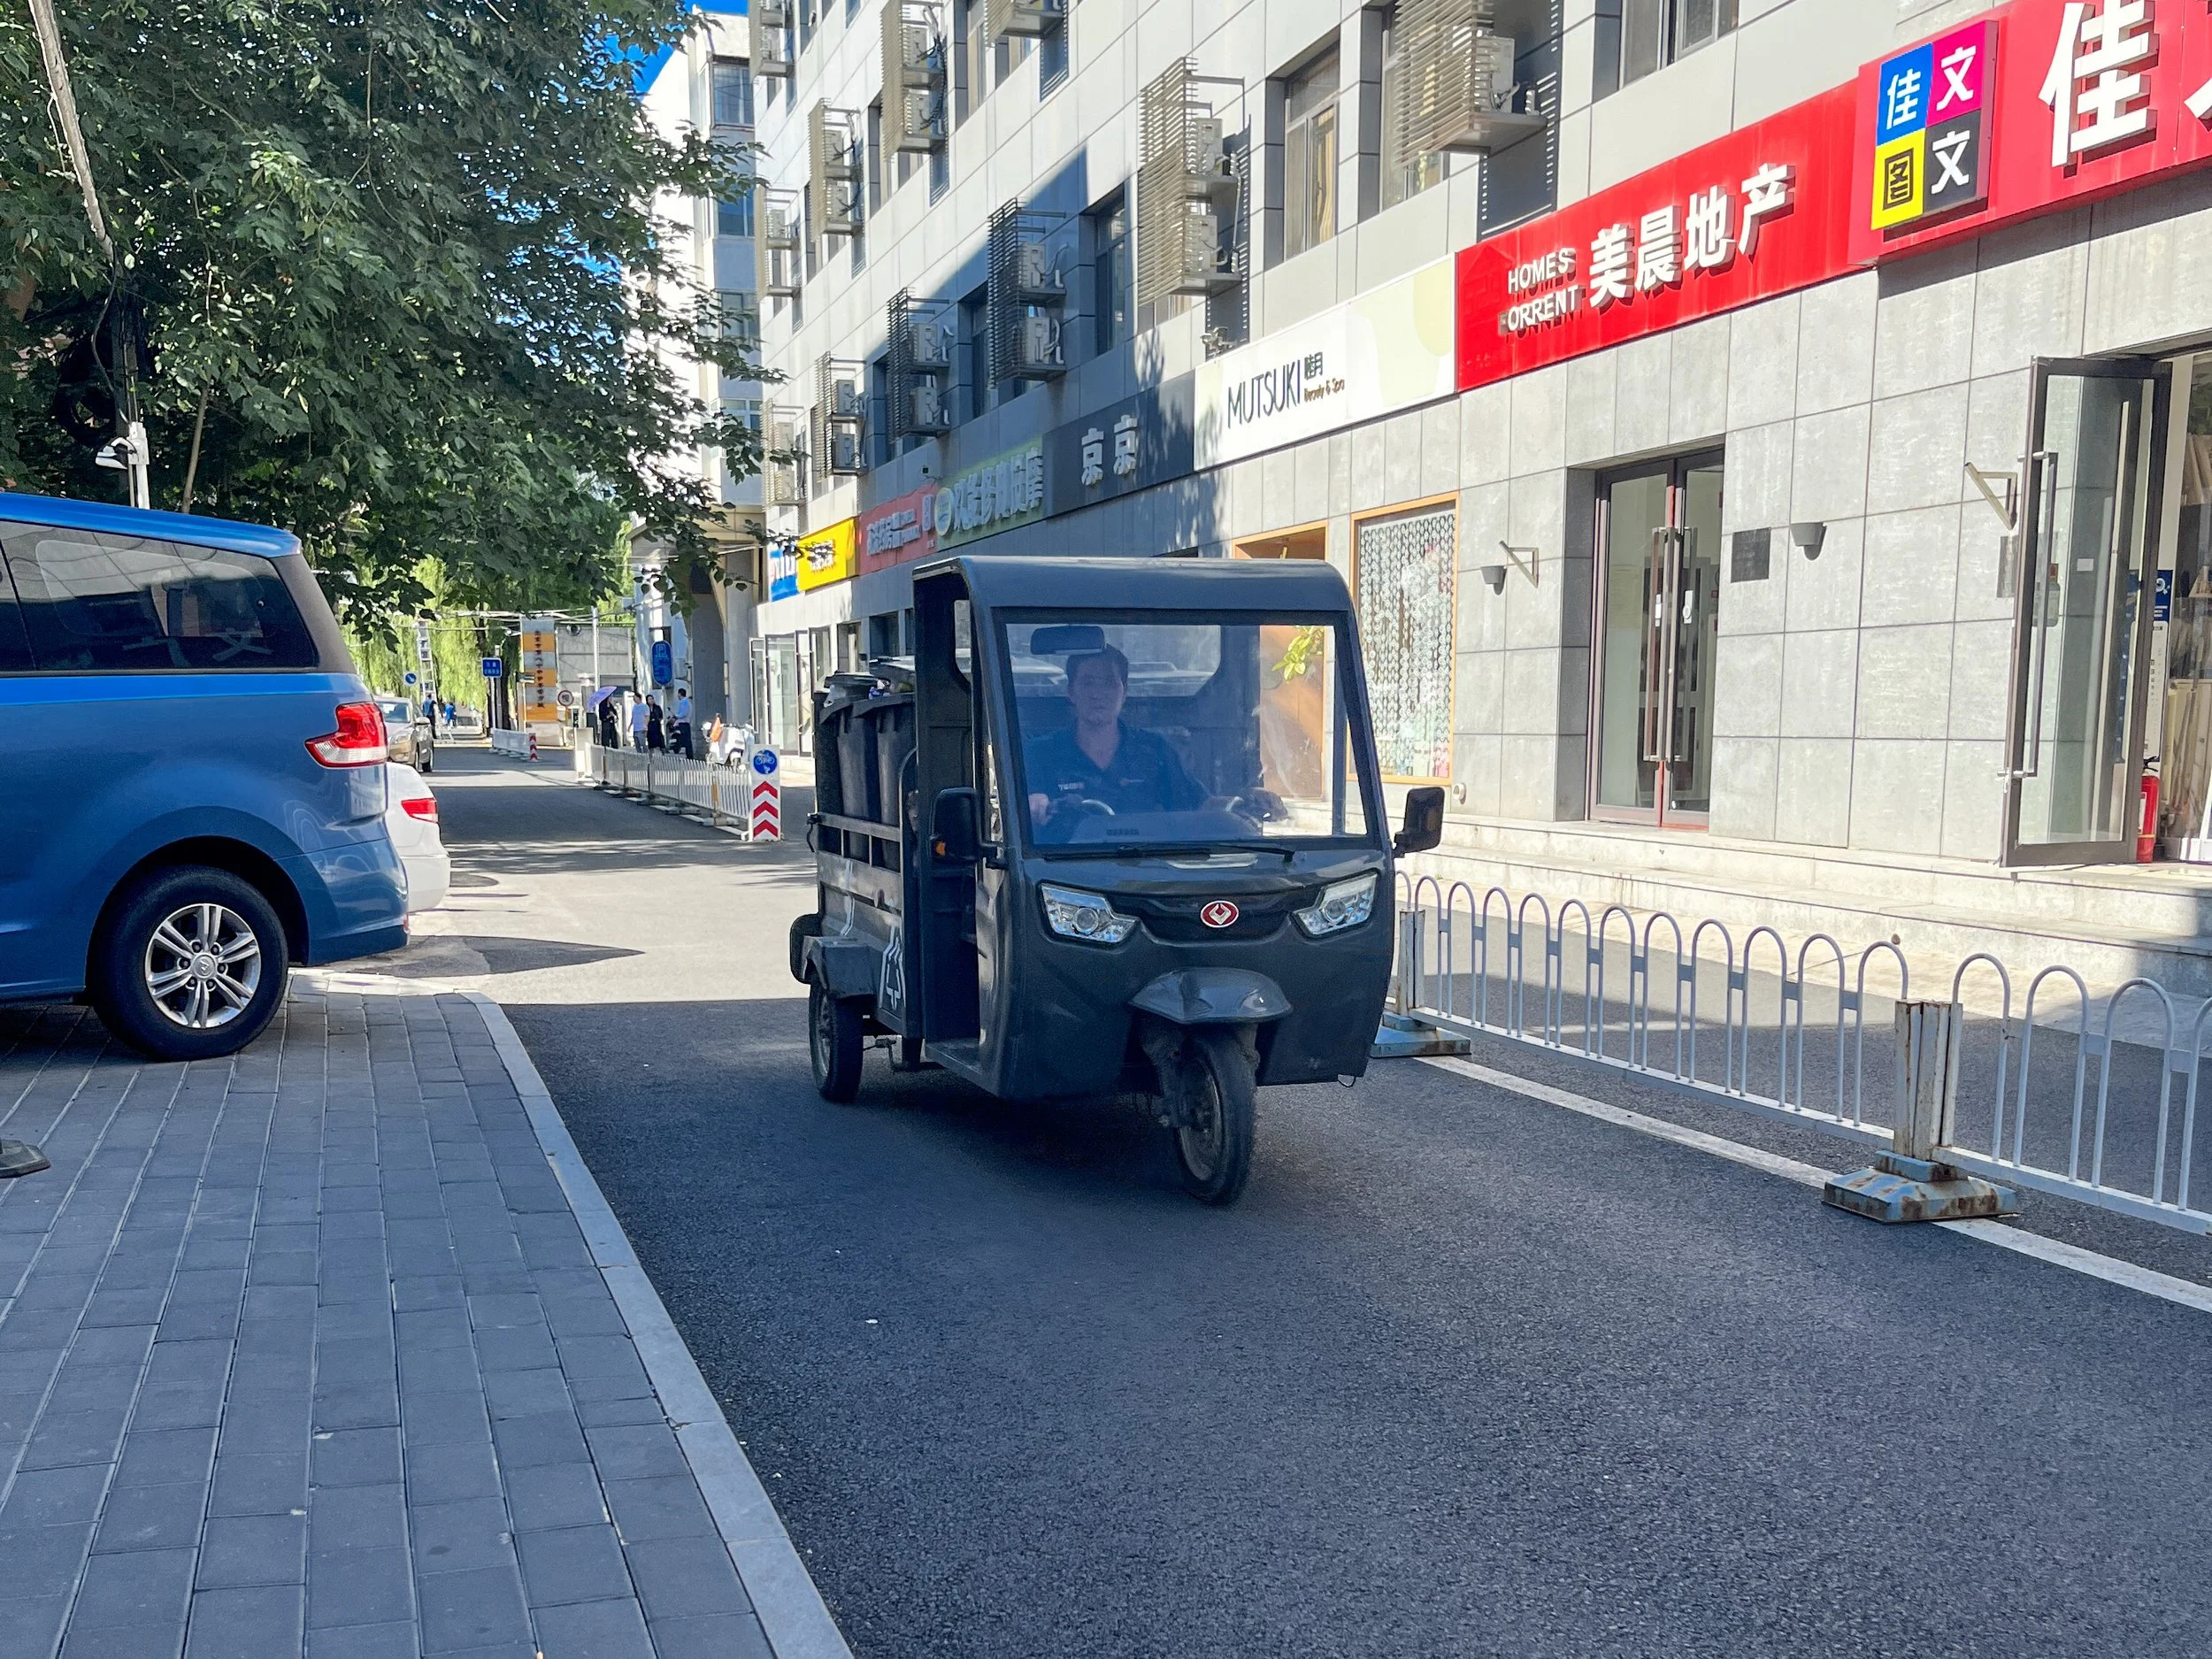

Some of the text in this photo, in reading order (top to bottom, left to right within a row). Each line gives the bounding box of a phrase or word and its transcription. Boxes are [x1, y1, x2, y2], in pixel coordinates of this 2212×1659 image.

[1886, 44, 1978, 130] 佳文
[2039, 0, 2212, 168] 佳
[1508, 248, 1573, 295] HOMES
[1590, 163, 1793, 308] 美晨地产
[1227, 359, 1301, 429] MUTSUKI
